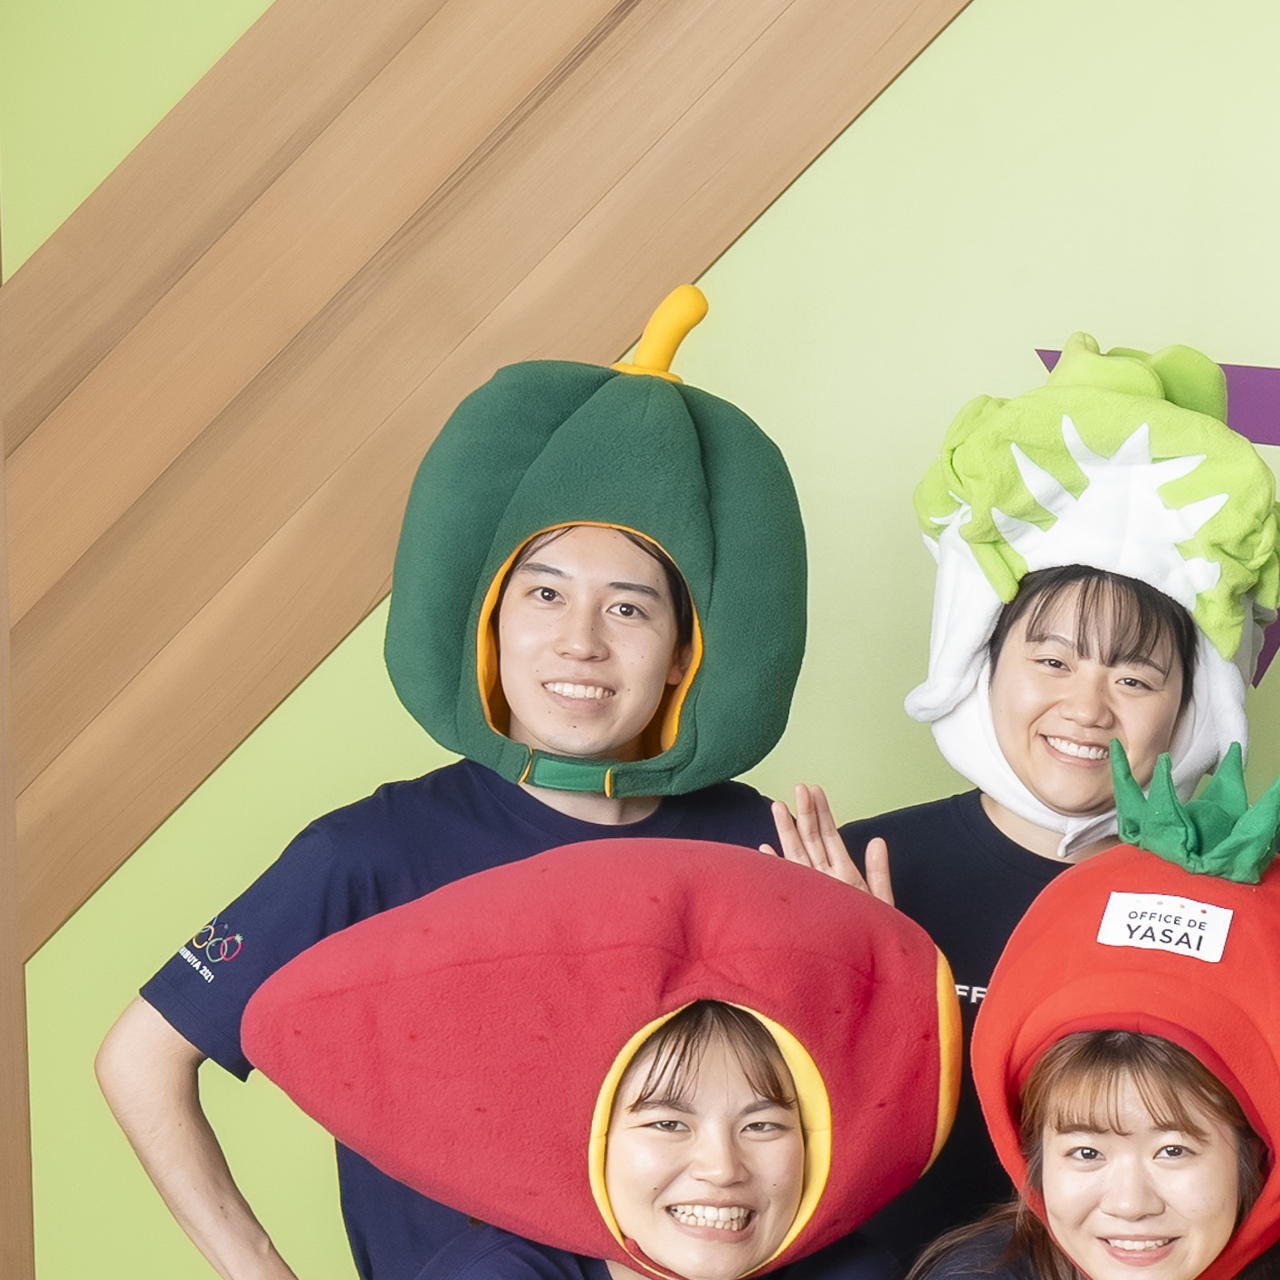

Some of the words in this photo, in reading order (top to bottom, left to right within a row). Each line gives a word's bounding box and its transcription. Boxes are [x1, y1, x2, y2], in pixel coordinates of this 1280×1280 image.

[1128, 911, 1182, 925] OFFICE
[1187, 919, 1207, 931] DE
[1126, 924, 1203, 951] YASAI
